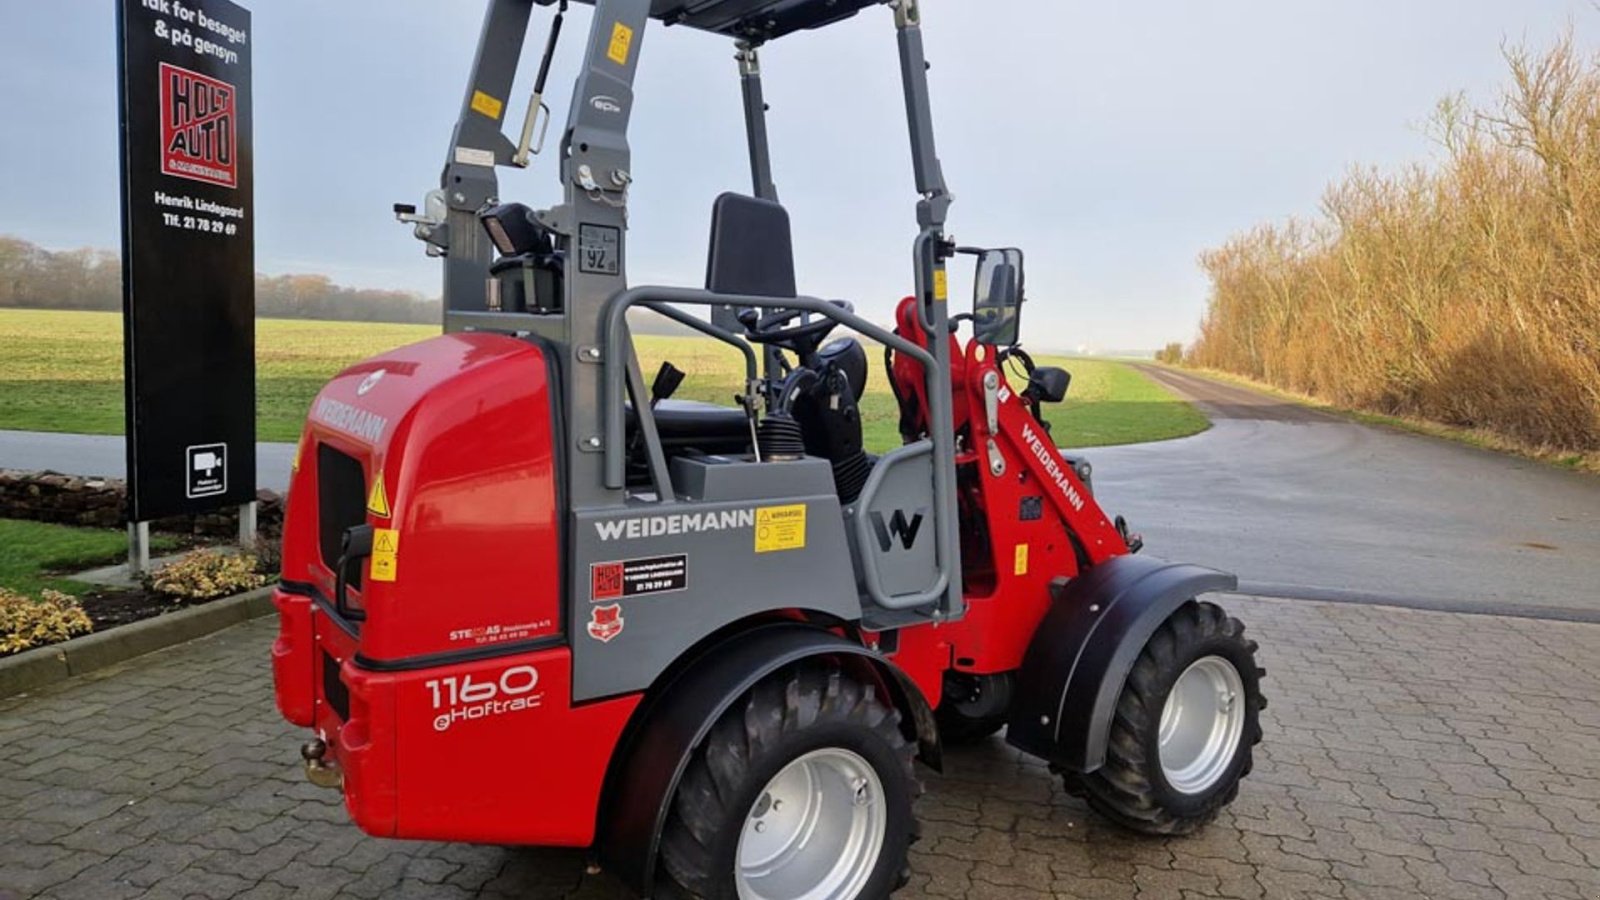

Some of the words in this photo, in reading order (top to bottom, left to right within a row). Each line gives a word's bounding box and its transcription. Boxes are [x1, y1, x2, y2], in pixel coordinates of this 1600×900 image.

[154, 20, 169, 39] &
[171, 28, 192, 46] på
[194, 37, 238, 64] gensyn
[172, 1, 195, 22] for
[198, 9, 246, 44] besøget
[170, 72, 231, 129] HOLT
[168, 112, 232, 166] AUTO
[155, 191, 193, 210] Henrik
[195, 198, 244, 218] Lindegaard
[163, 213, 181, 227] Tlf.
[183, 216, 195, 229] 21
[197, 218, 210, 231] 78
[211, 221, 224, 233] 29
[225, 223, 237, 235] 69
[587, 245, 605, 269] 92
[316, 397, 387, 443] WEIDEMANN
[1021, 423, 1084, 512] WEIDEMANN
[594, 508, 755, 541] WEIDEMANN
[426, 665, 538, 709] 1160
